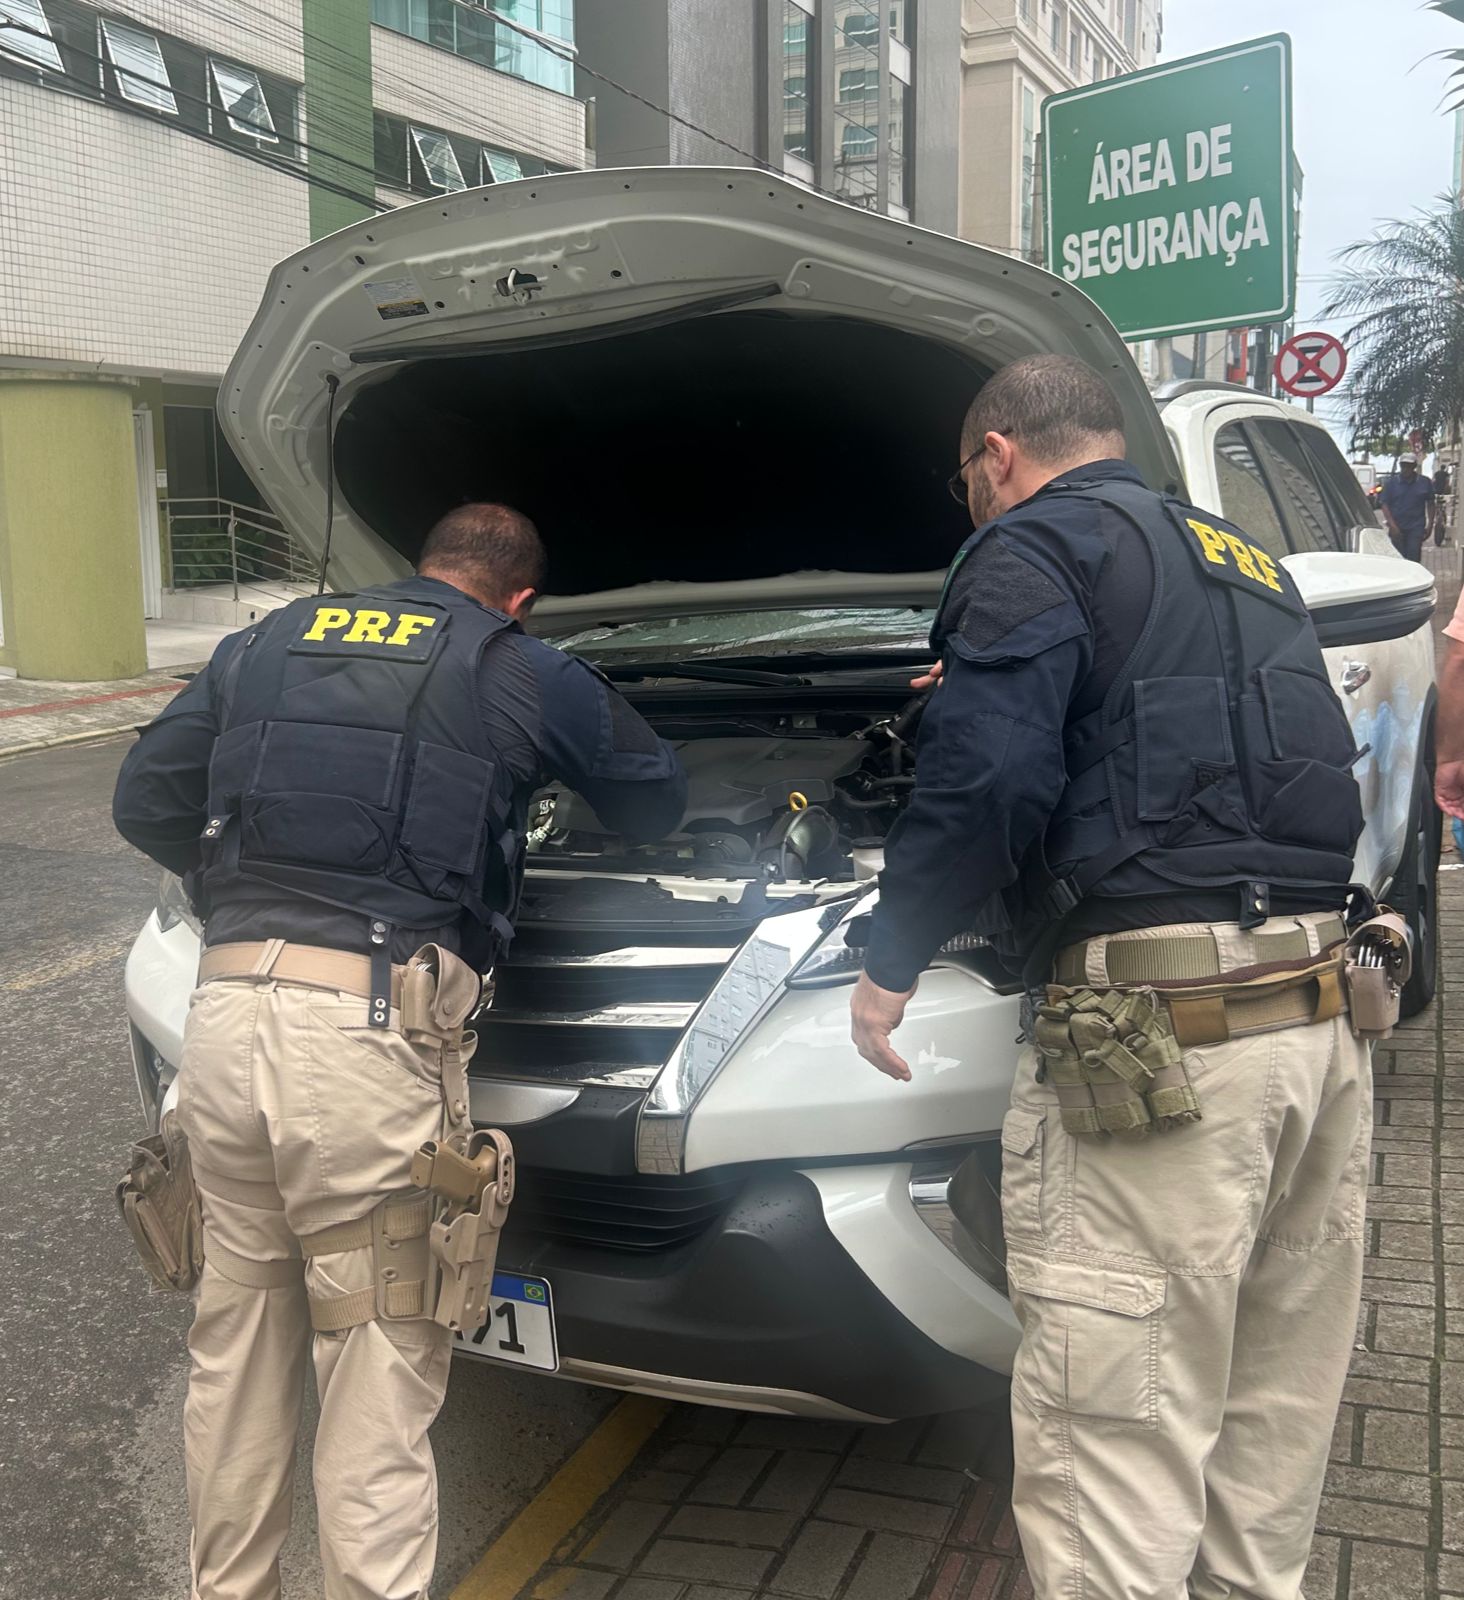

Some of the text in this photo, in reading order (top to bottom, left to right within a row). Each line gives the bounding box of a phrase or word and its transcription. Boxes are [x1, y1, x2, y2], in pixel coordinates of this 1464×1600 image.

[1088, 123, 1233, 204] ÁREA DE
[1062, 197, 1270, 282] SEGURANÇA
[1185, 518, 1284, 594] PRF
[302, 607, 436, 646] PRF
